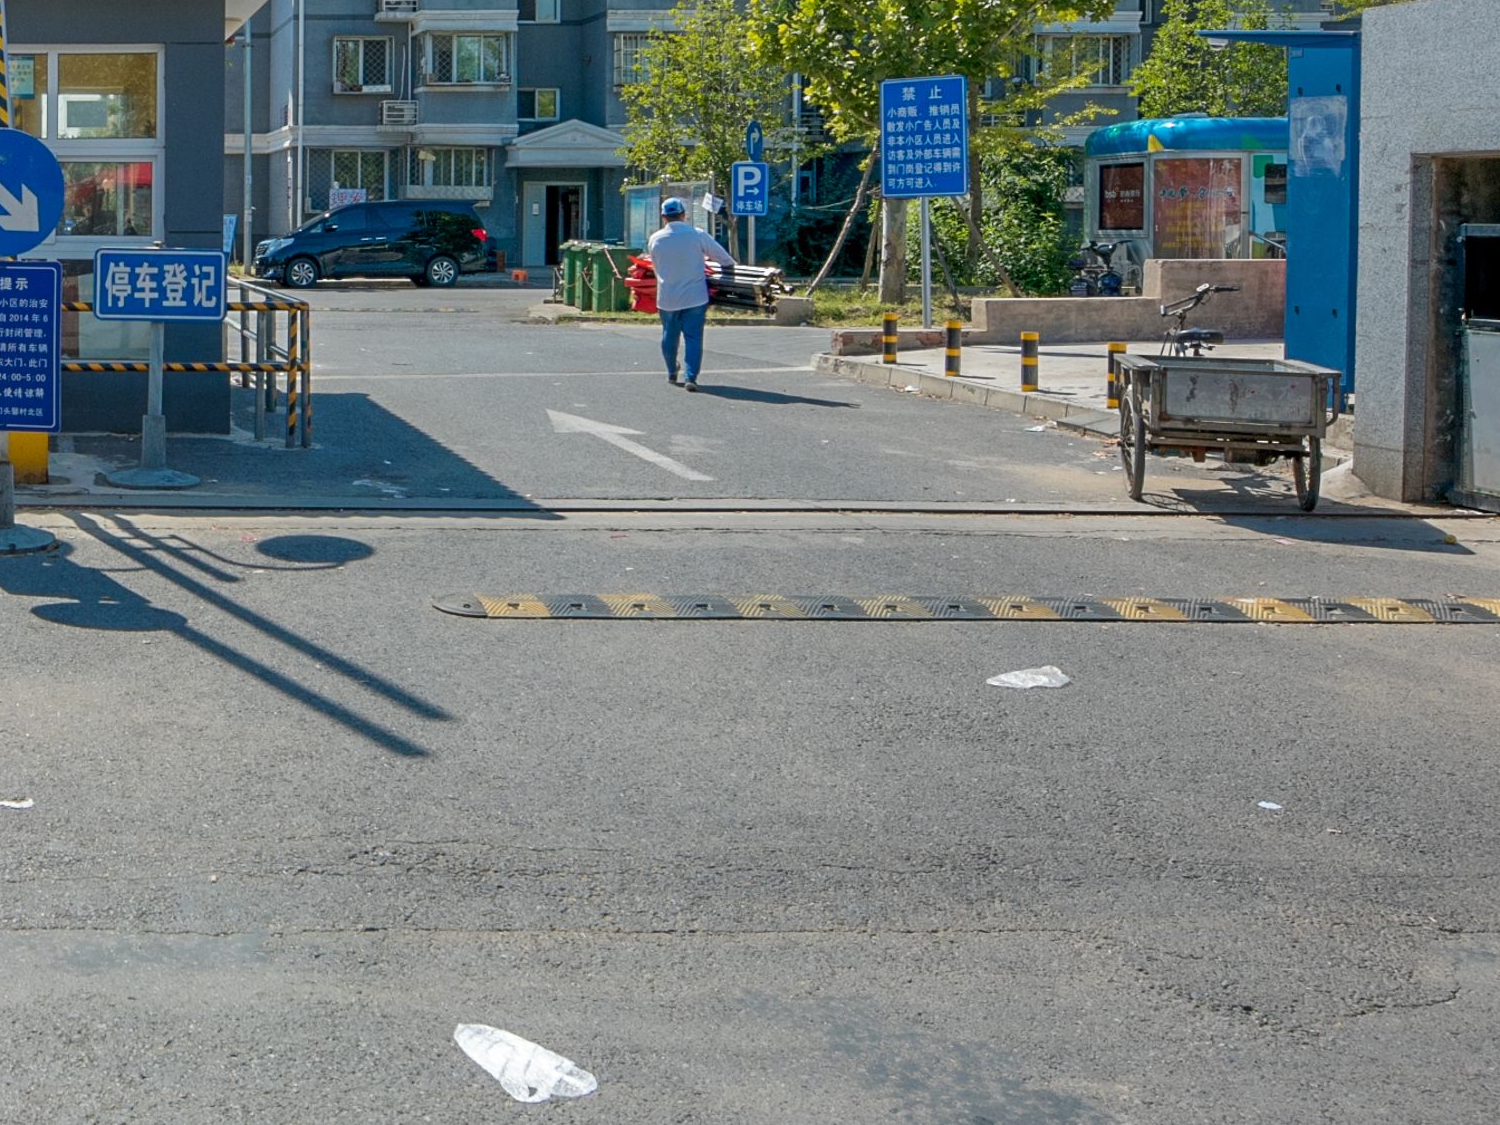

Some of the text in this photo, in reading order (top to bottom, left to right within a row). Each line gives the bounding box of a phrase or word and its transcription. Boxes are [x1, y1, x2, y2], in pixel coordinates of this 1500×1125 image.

[901, 85, 943, 101] 禁止
[887, 133, 961, 146] 非本小区人员进入
[738, 166, 761, 196] P
[736, 200, 763, 212] 停车场
[105, 261, 217, 307] 停车登记
